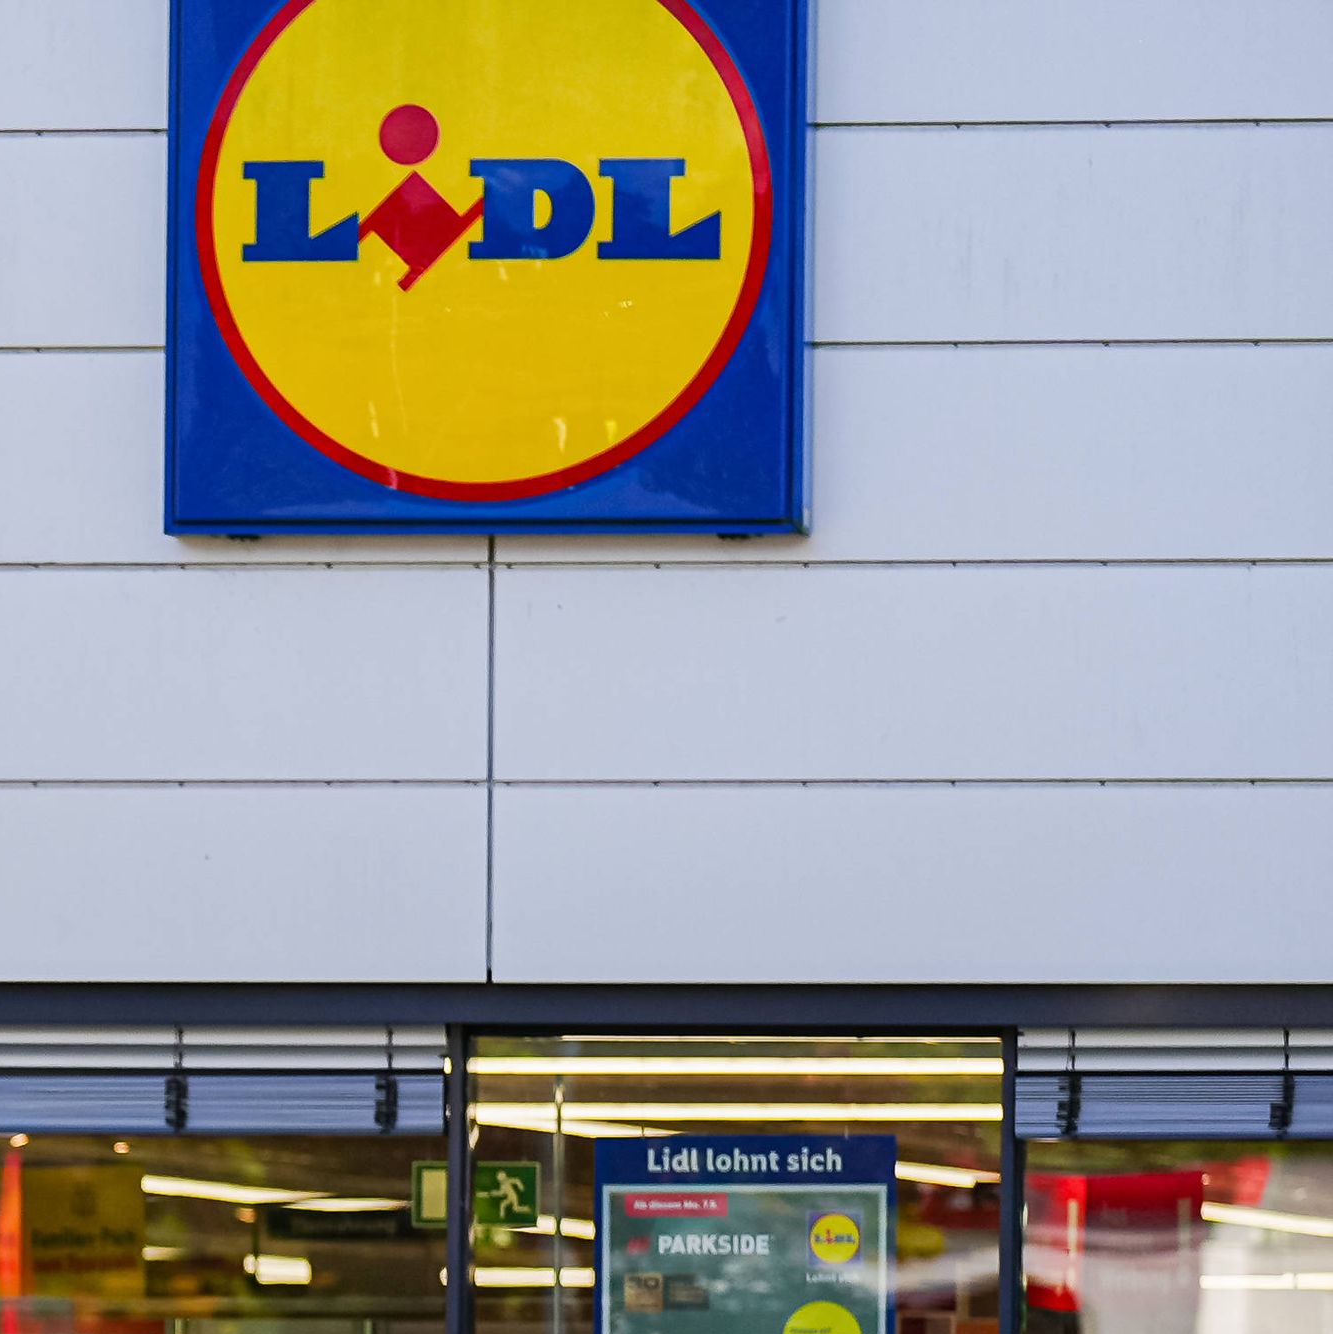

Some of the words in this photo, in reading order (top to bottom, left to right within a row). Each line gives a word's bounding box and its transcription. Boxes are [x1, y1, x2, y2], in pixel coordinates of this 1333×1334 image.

[647, 1147, 698, 1173] Lidl
[706, 1147, 780, 1173] lohnt
[787, 1147, 842, 1173] sich
[657, 1233, 770, 1255] PARKSIDE
